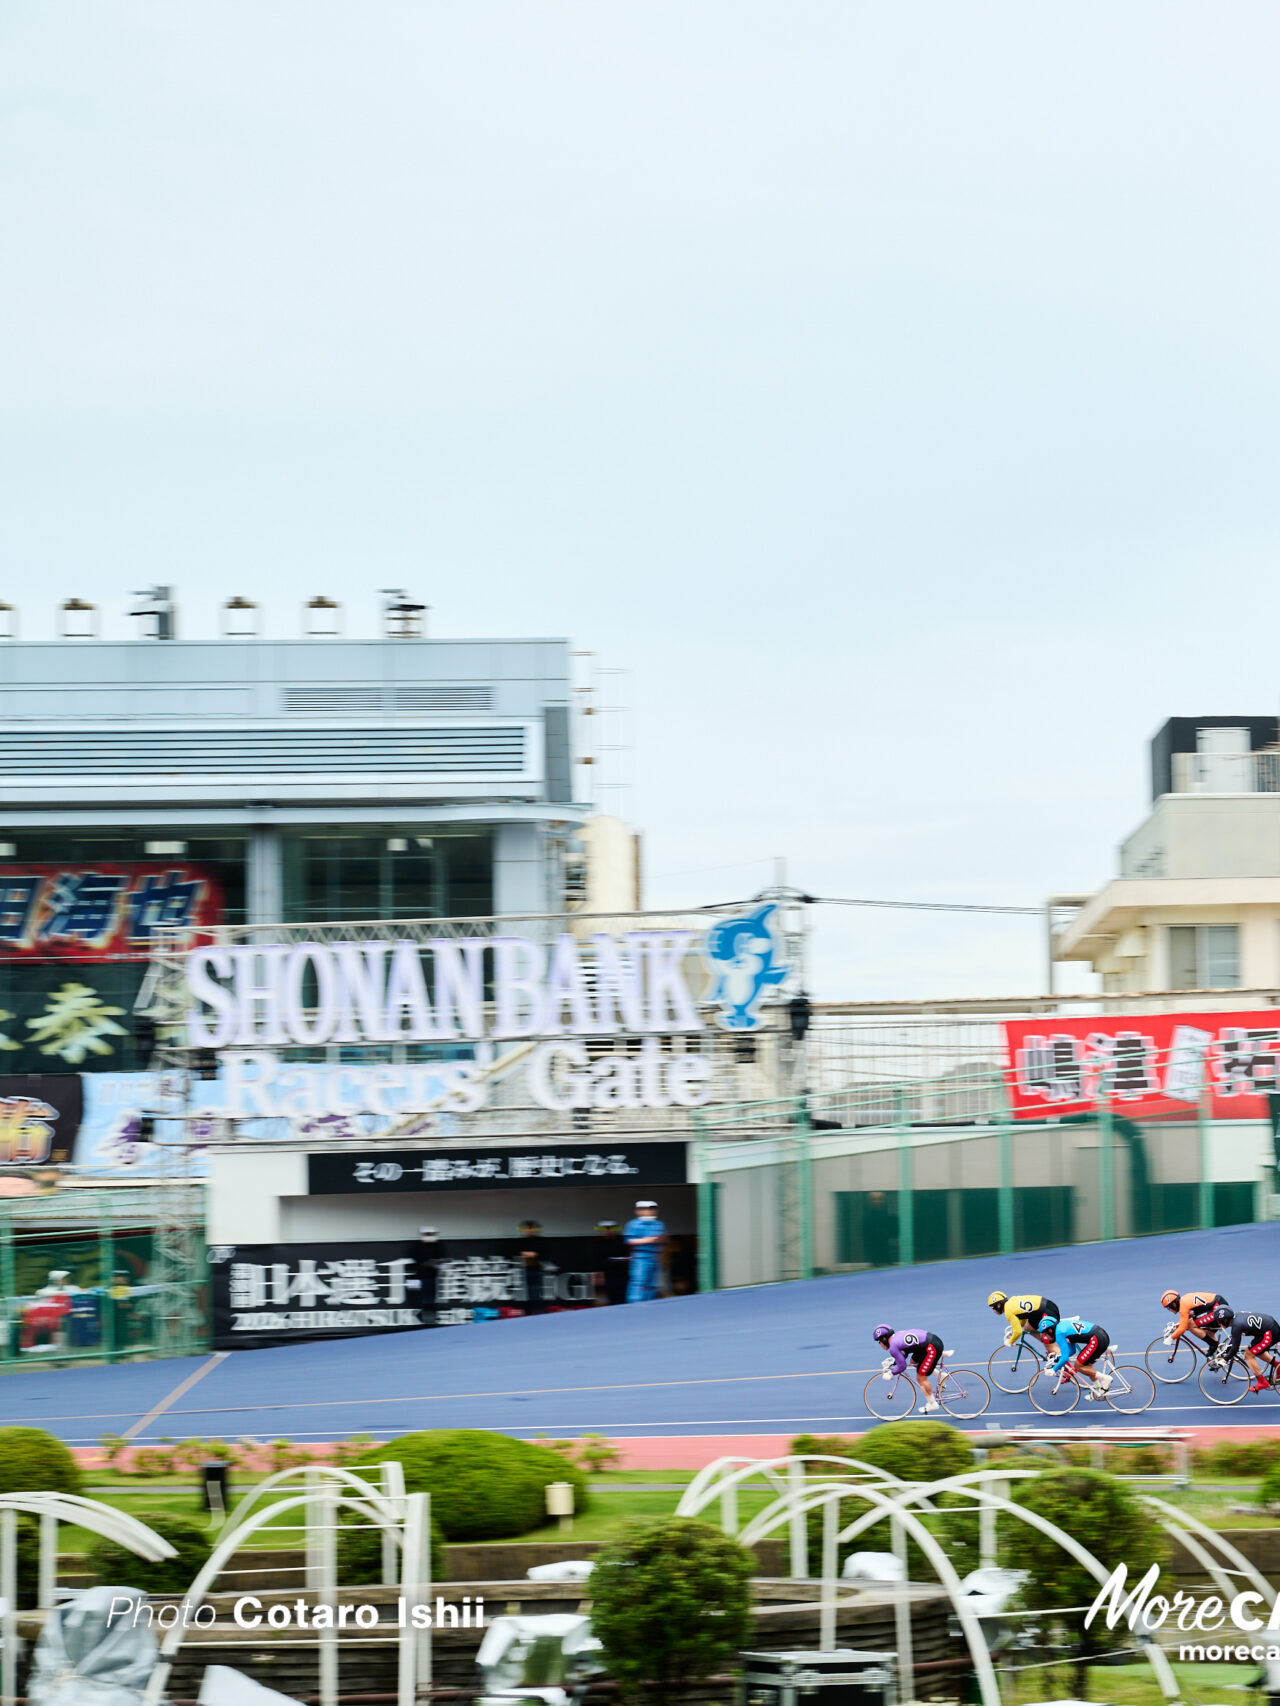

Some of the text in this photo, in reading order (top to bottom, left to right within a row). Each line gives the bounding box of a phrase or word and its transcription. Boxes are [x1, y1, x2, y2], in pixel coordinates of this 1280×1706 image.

[187, 938, 494, 1049] SHONAN
[491, 929, 702, 1038] BANK
[531, 1037, 712, 1110] Gate
[1019, 1300, 1034, 1313] 5
[1194, 1294, 1207, 1307] 7
[1072, 1321, 1086, 1334] 4
[1248, 1315, 1263, 1330] 2
[904, 1332, 920, 1346] 9
